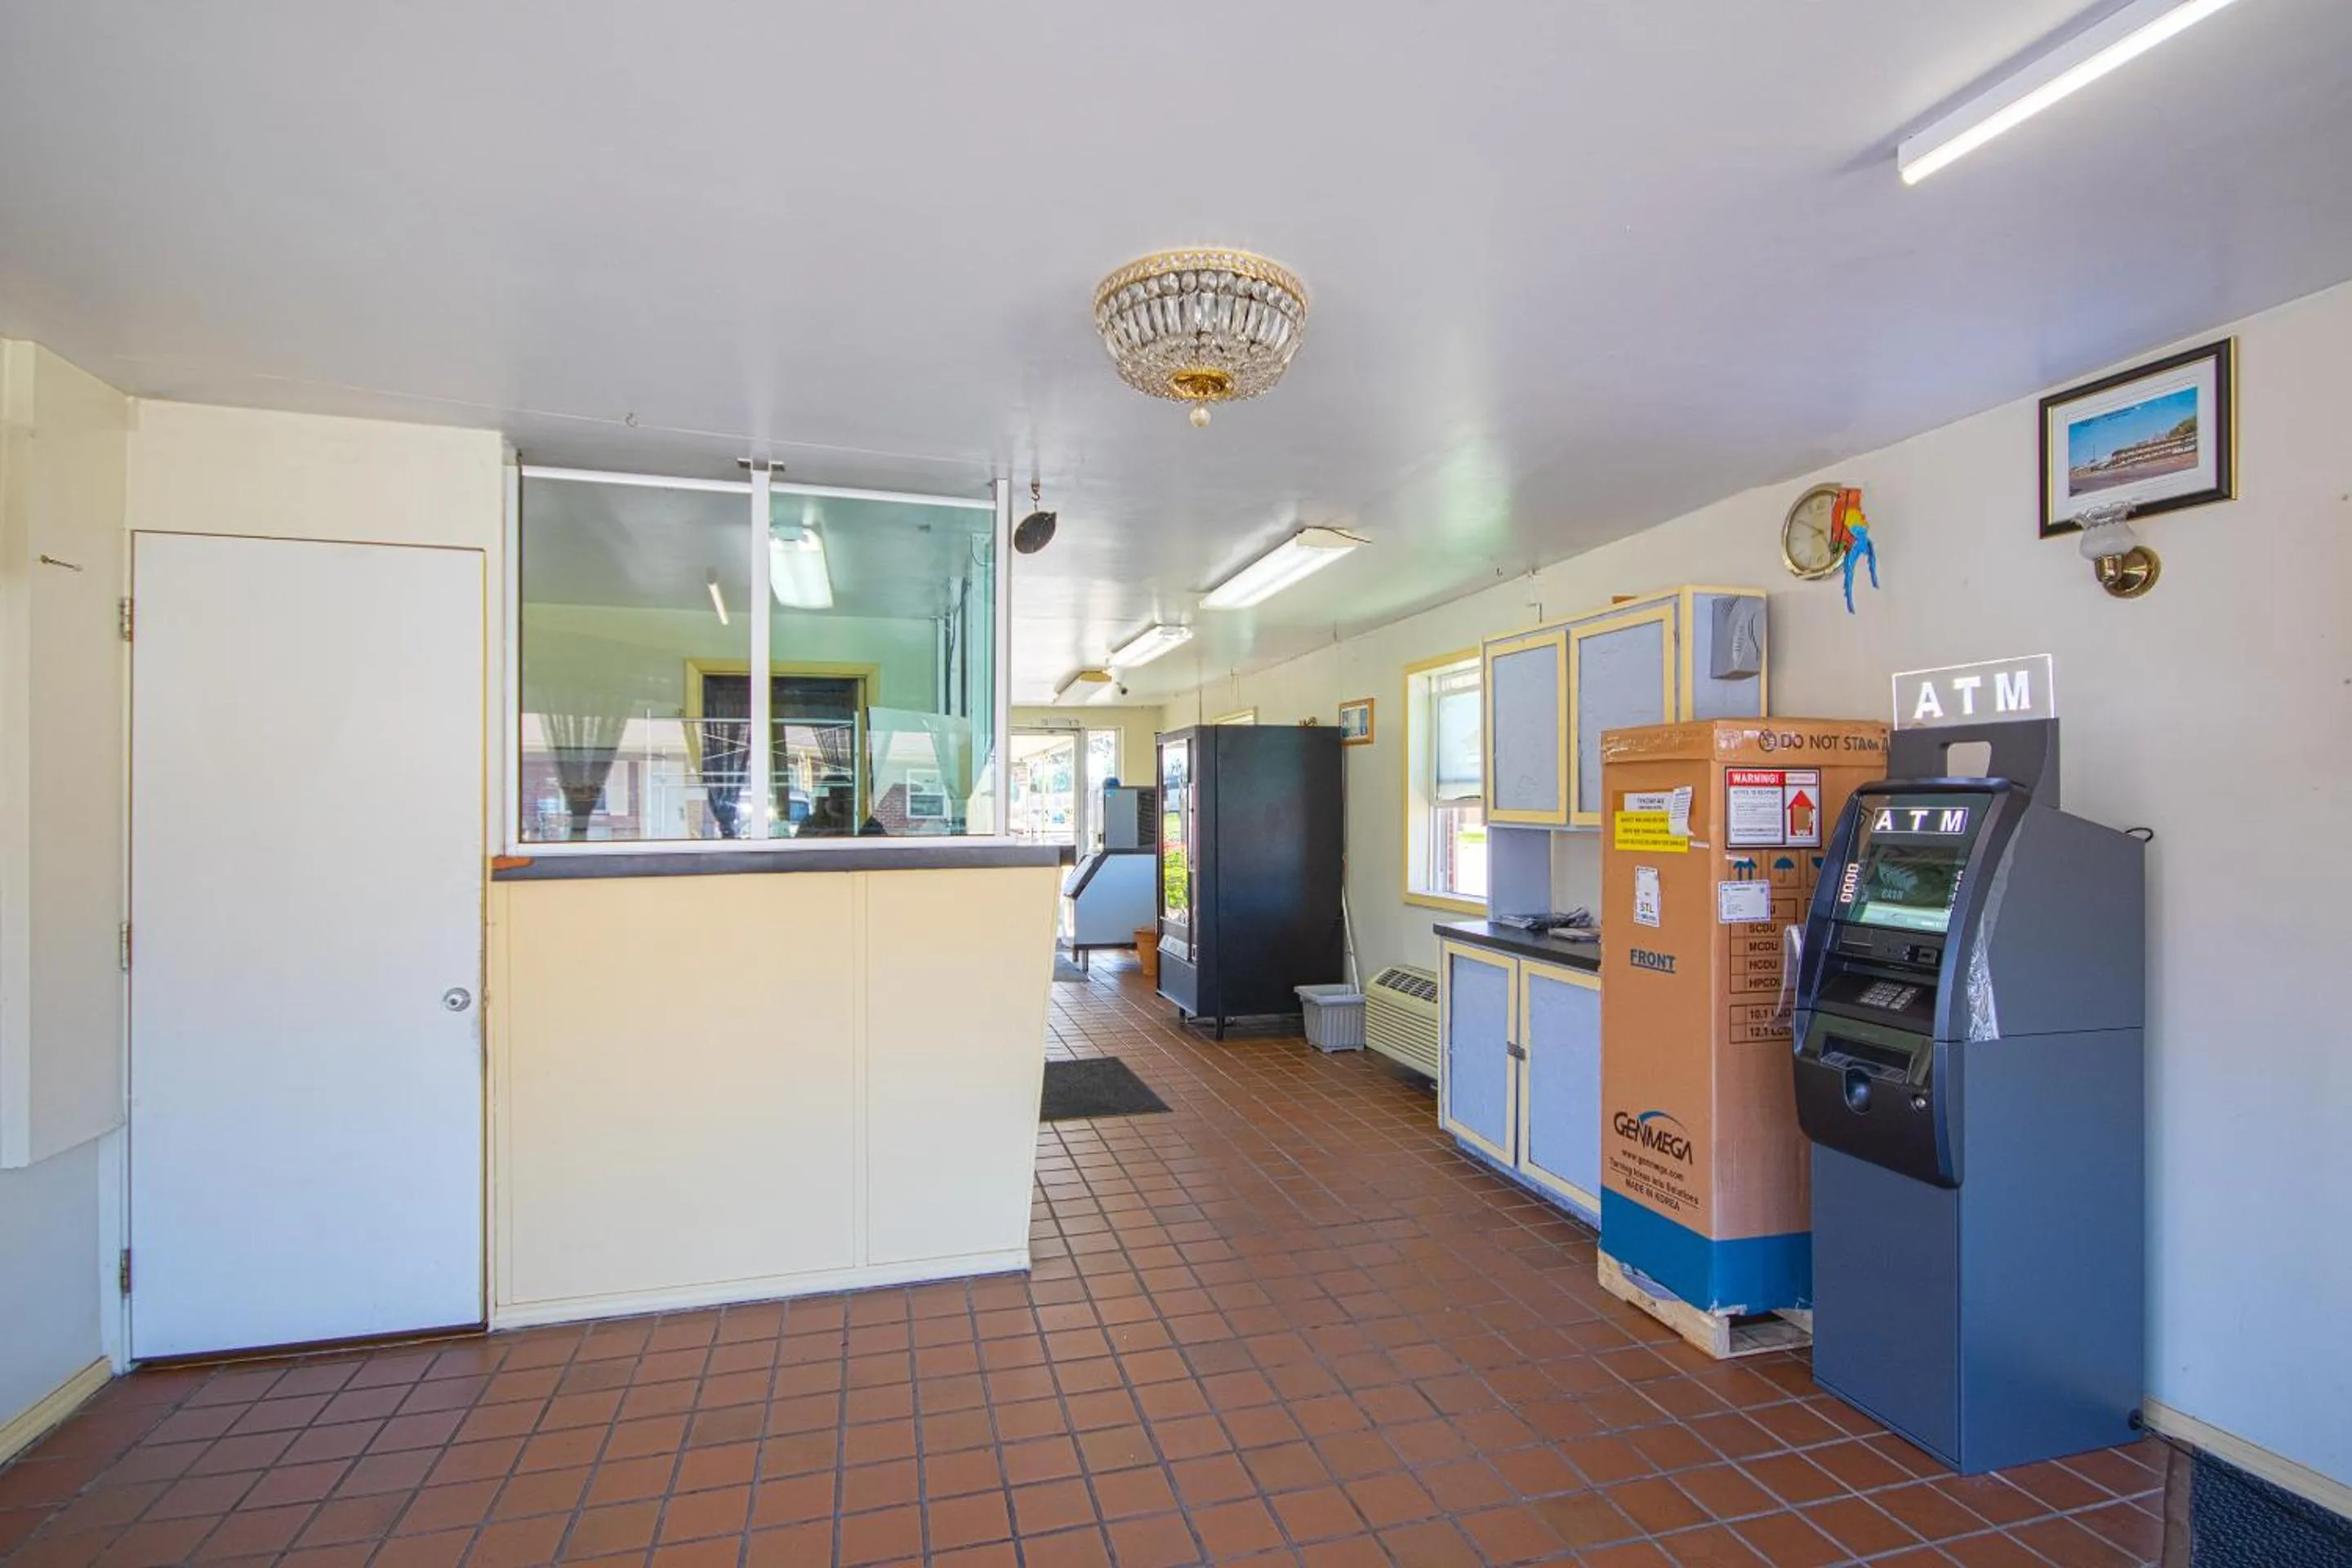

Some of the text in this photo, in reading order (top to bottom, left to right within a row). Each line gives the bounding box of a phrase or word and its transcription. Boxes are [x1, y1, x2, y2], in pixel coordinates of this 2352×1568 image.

[1913, 670, 2032, 719] ATM
[1780, 733, 1804, 750] DO
[1810, 735, 1839, 750] NOT
[1732, 772, 1780, 784] WARNING!
[1875, 809, 1965, 832] ATM
[1640, 902, 1655, 913] STL
[1748, 941, 1779, 951] MCDU
[1630, 949, 1677, 970] FRONT
[1748, 959, 1778, 970] HCDU
[1749, 1027, 1768, 1038] 12.1
[1613, 1111, 1693, 1165] GENMEGA
